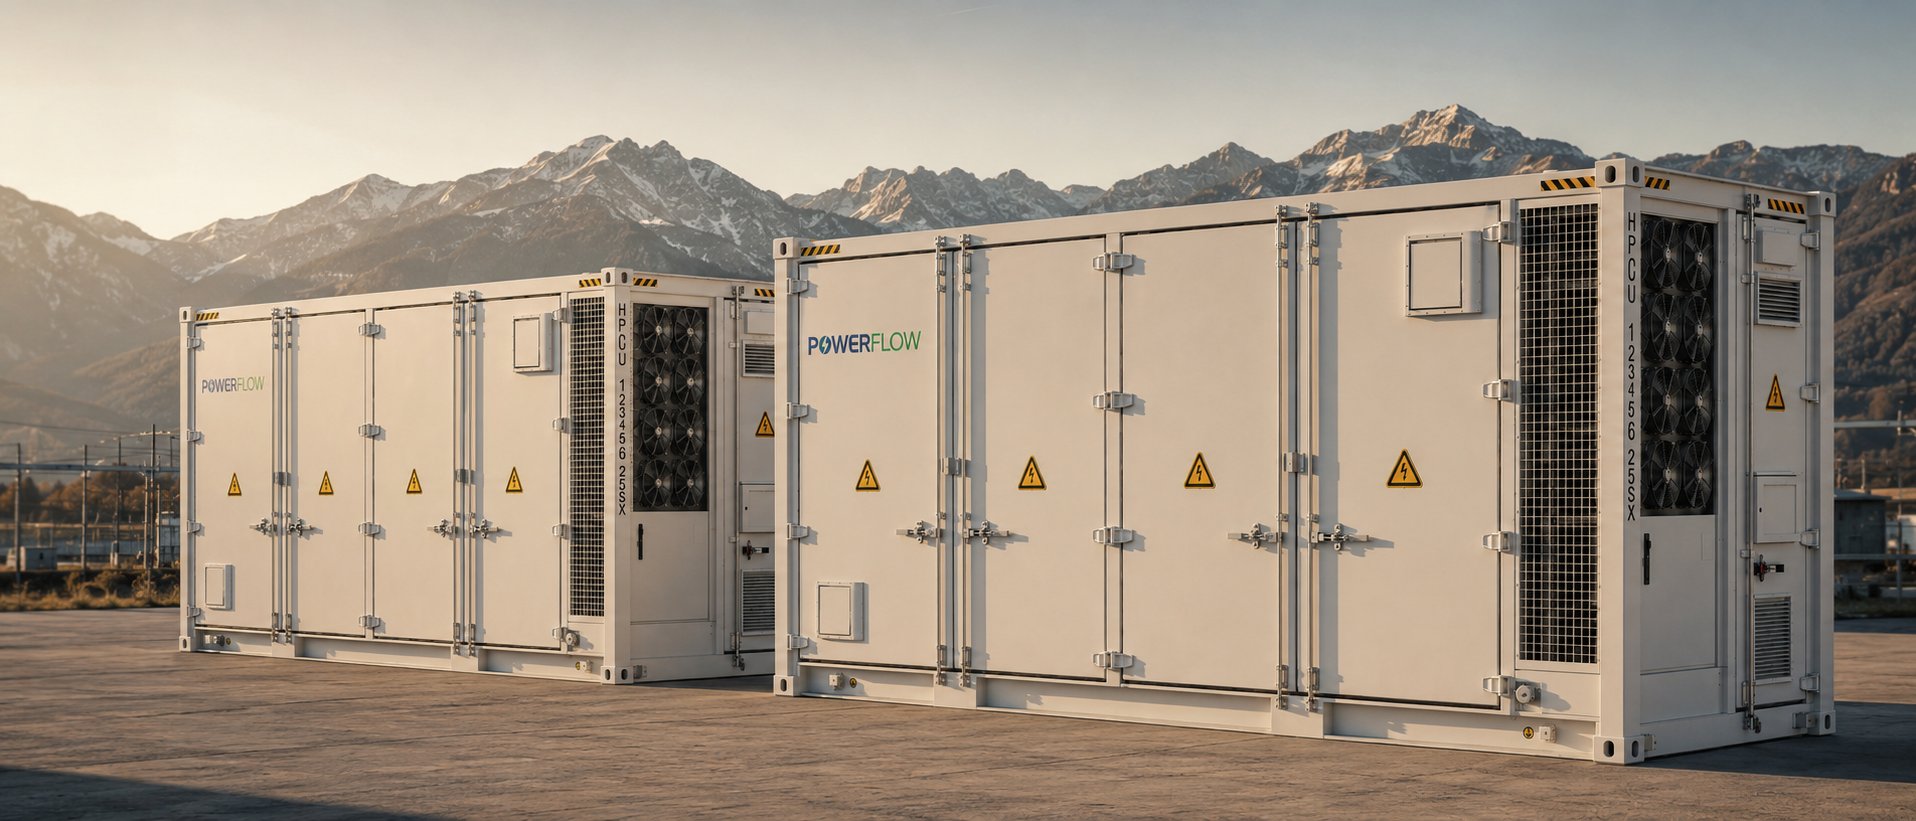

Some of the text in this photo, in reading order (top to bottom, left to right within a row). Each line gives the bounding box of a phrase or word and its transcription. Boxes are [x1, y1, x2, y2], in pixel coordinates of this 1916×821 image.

[201, 376, 265, 394] POWERFLOW
[808, 330, 922, 355] POWERFLOW
[1627, 211, 1637, 522] HPCU 123456 25SX
[618, 302, 627, 516] HPCU 123456 25SX
